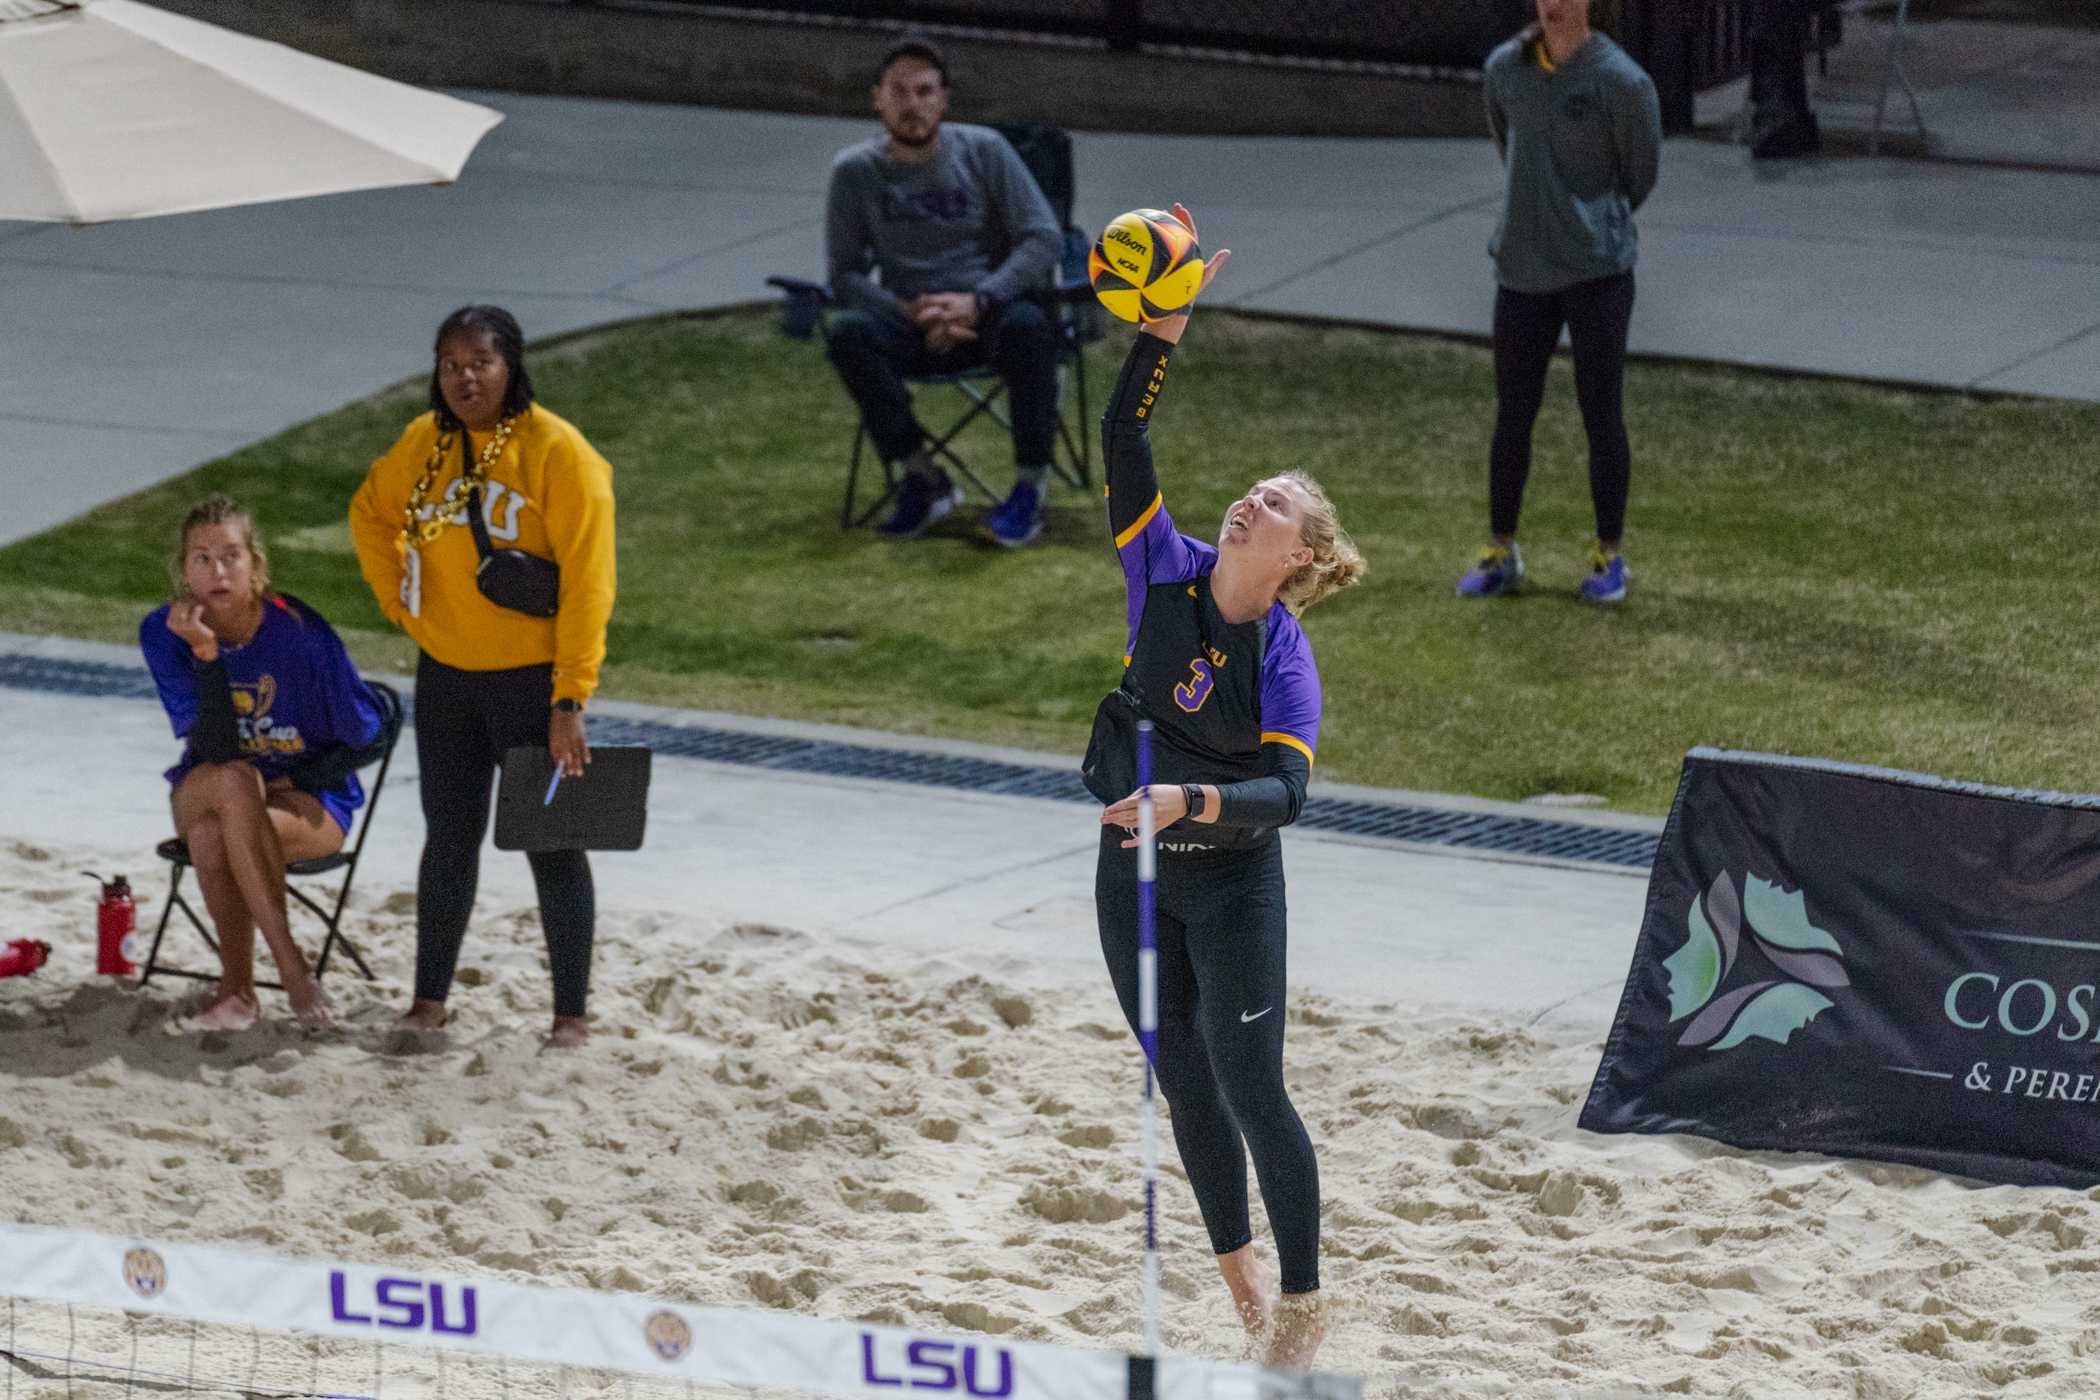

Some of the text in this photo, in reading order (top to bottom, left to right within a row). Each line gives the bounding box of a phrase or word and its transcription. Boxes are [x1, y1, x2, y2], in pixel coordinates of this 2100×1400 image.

[1106, 229, 1148, 256] Wilson
[1117, 257, 1140, 273] NCAA
[1173, 657, 1215, 713] 3
[1944, 971, 2100, 1044] COS
[1964, 1061, 2100, 1102] & PERE
[329, 1271, 477, 1336] LSU
[862, 1333, 1013, 1398] LSU
